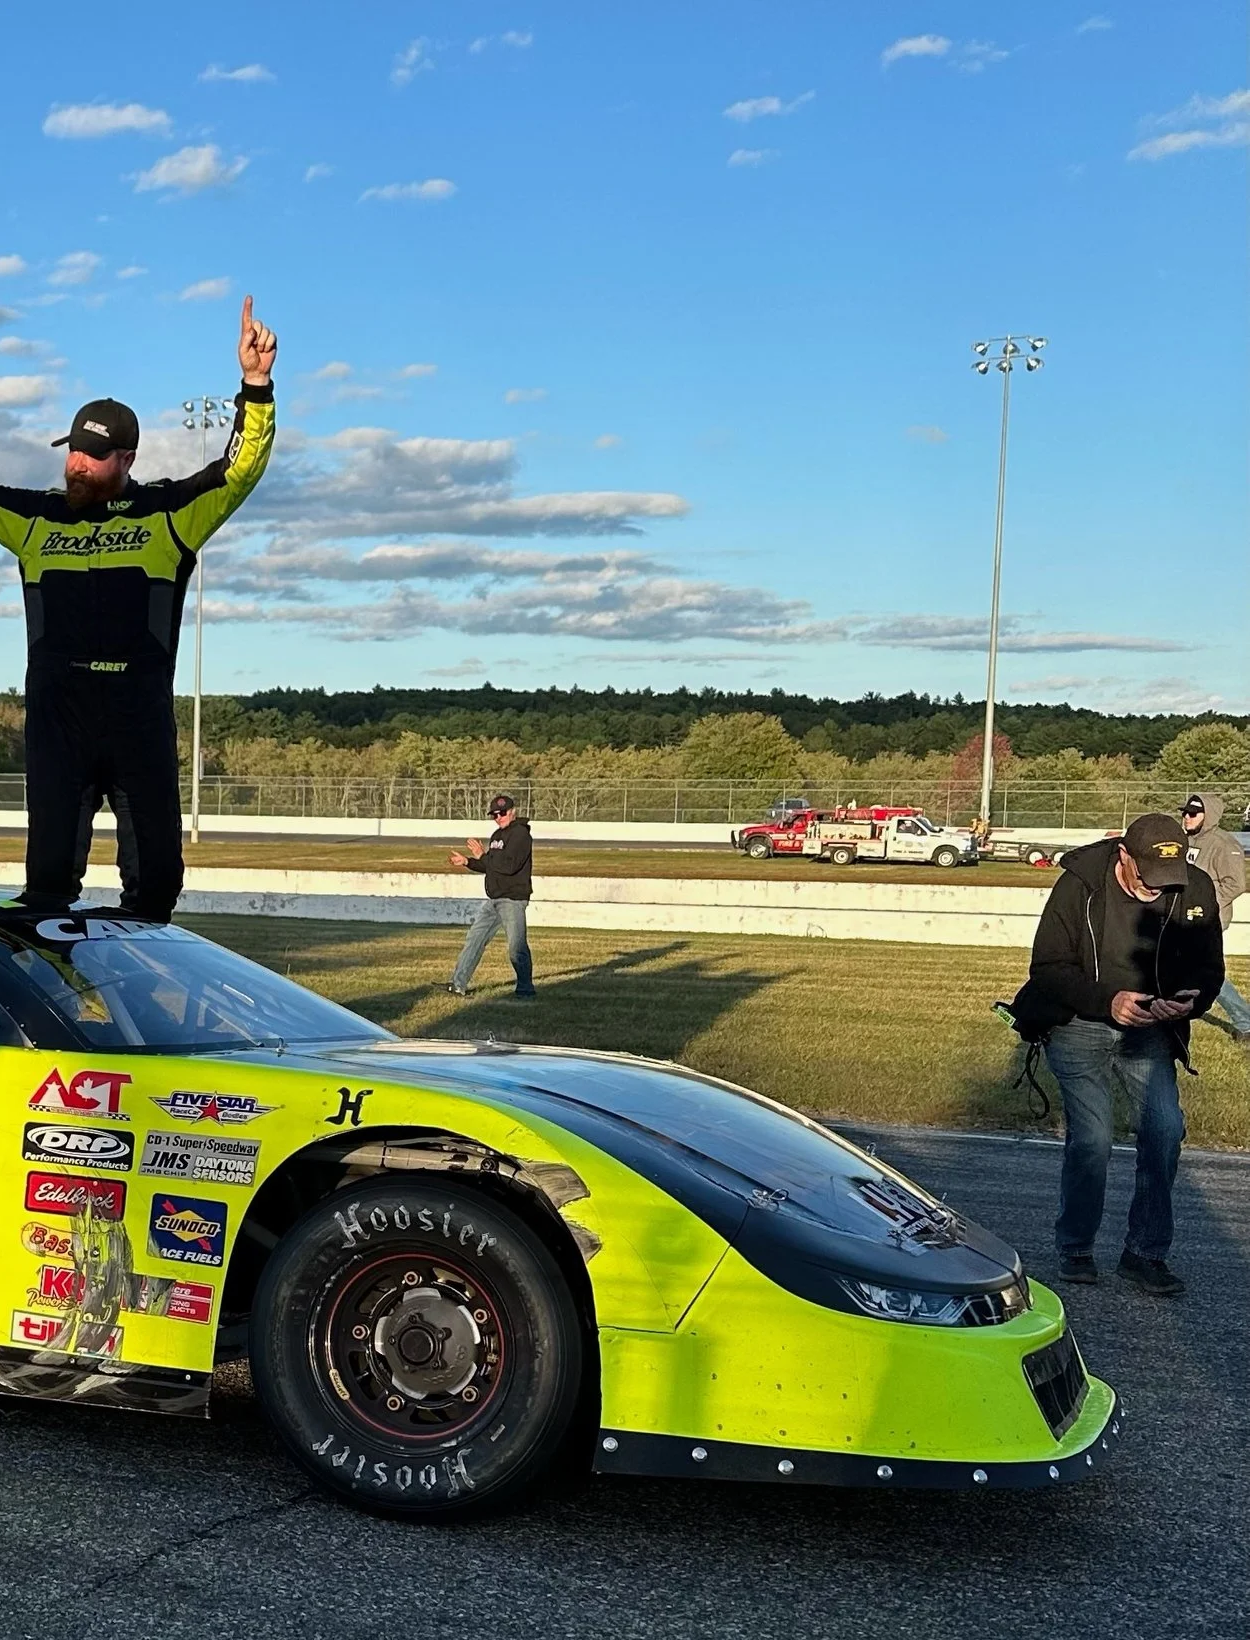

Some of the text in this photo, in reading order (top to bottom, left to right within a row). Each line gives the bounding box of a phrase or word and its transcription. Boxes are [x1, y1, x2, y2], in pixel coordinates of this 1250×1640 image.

[40, 525, 152, 551] Brookside
[90, 661, 128, 671] CAREY
[29, 1067, 132, 1113] ACT
[170, 1092, 256, 1112] FIVE STAR
[324, 1086, 374, 1127] H
[40, 1131, 118, 1153] DRP
[146, 1134, 170, 1146] CD-1
[206, 1139, 260, 1157] Speedway
[24, 1151, 130, 1171] Performance Products
[142, 1151, 191, 1170] JMS
[195, 1156, 255, 1173] DAYTONA
[192, 1167, 253, 1185] SENSORS
[157, 1217, 218, 1236] SUNOCO
[333, 1201, 498, 1257] Hoosier
[160, 1247, 222, 1266] ACE FUELS
[312, 1434, 477, 1497] Hoosier
